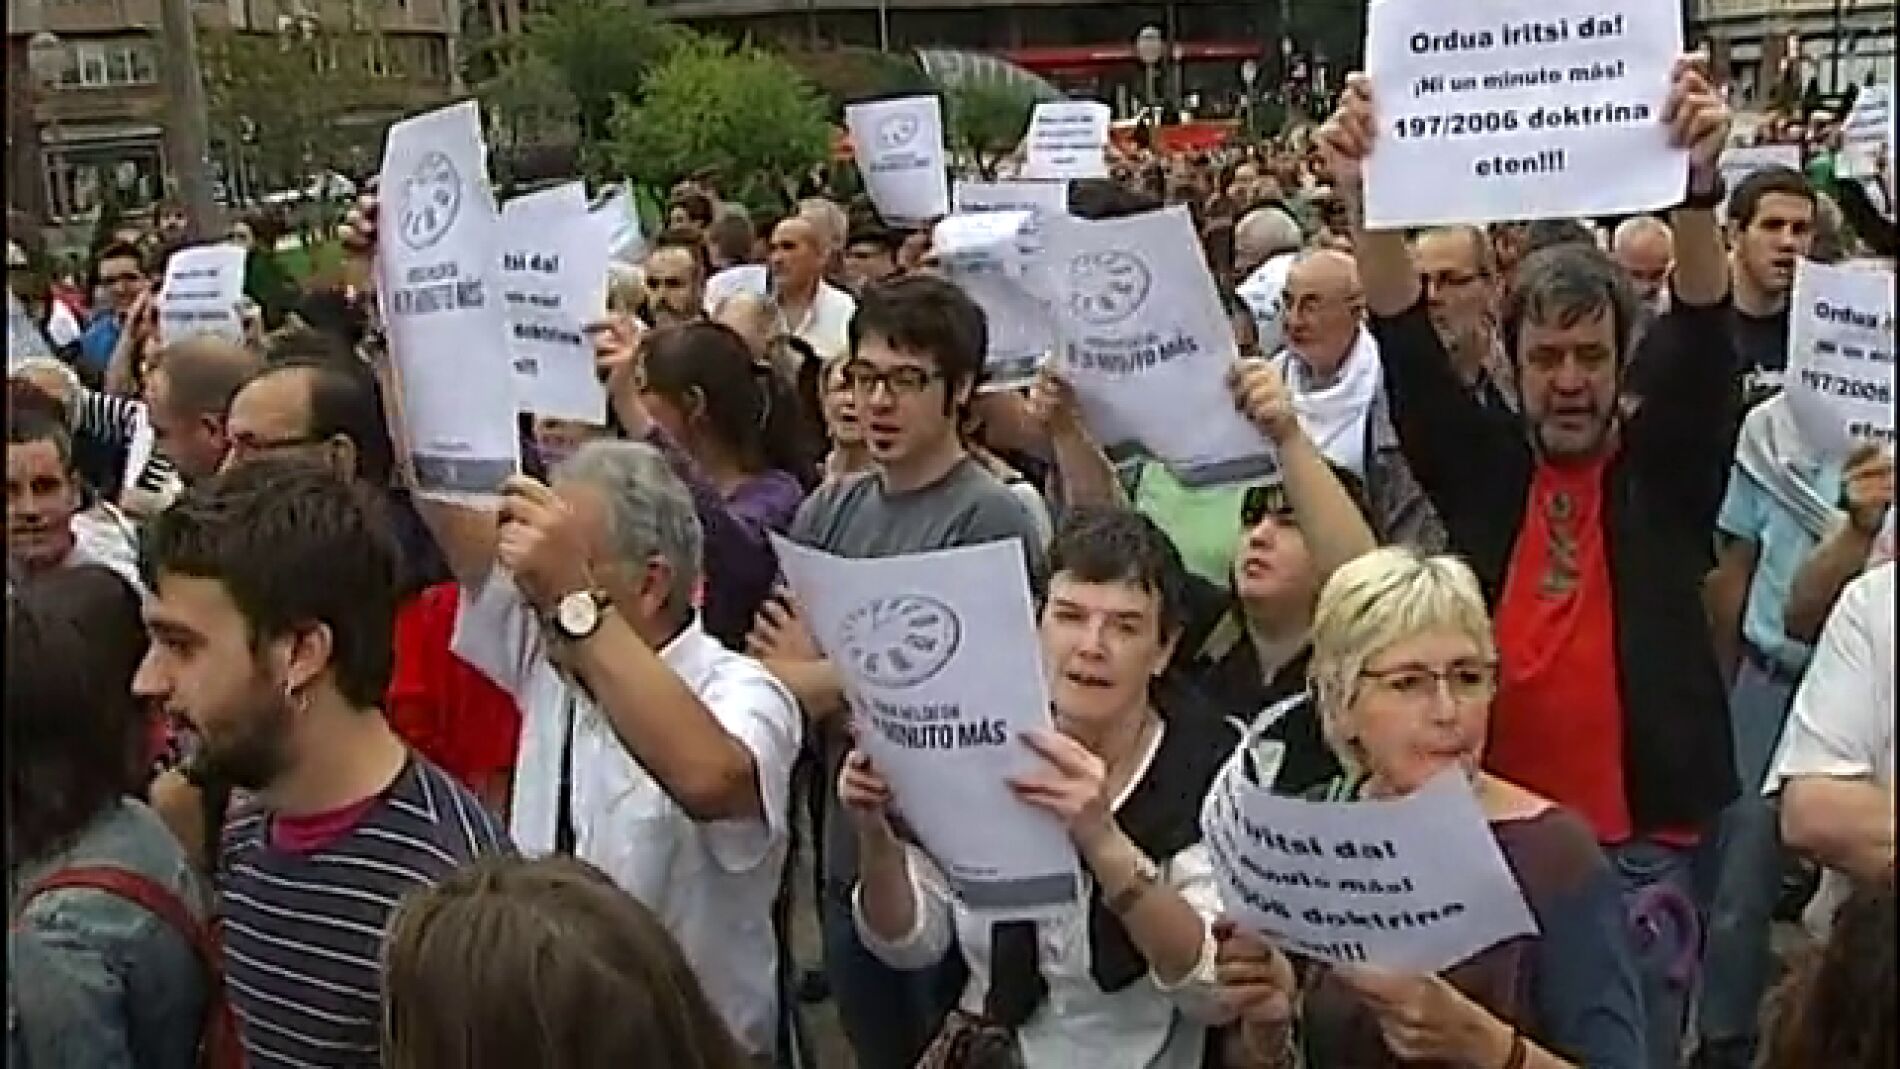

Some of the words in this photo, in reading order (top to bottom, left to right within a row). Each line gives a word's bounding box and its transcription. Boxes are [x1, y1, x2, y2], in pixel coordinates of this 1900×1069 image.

[1410, 30, 1494, 53] Ordua
[1502, 18, 1568, 46] iritsi
[1577, 13, 1624, 39] da!
[1450, 77, 1477, 93] un
[1483, 65, 1562, 90] minuto
[1569, 59, 1625, 83] más!
[1395, 109, 1518, 138] 197/2006
[1527, 103, 1649, 129] doktrina
[1474, 148, 1566, 176] eten!!!
[1815, 302, 1878, 328] Ordua
[958, 715, 1008, 749] MÁS
[1302, 901, 1466, 930] doktrina
